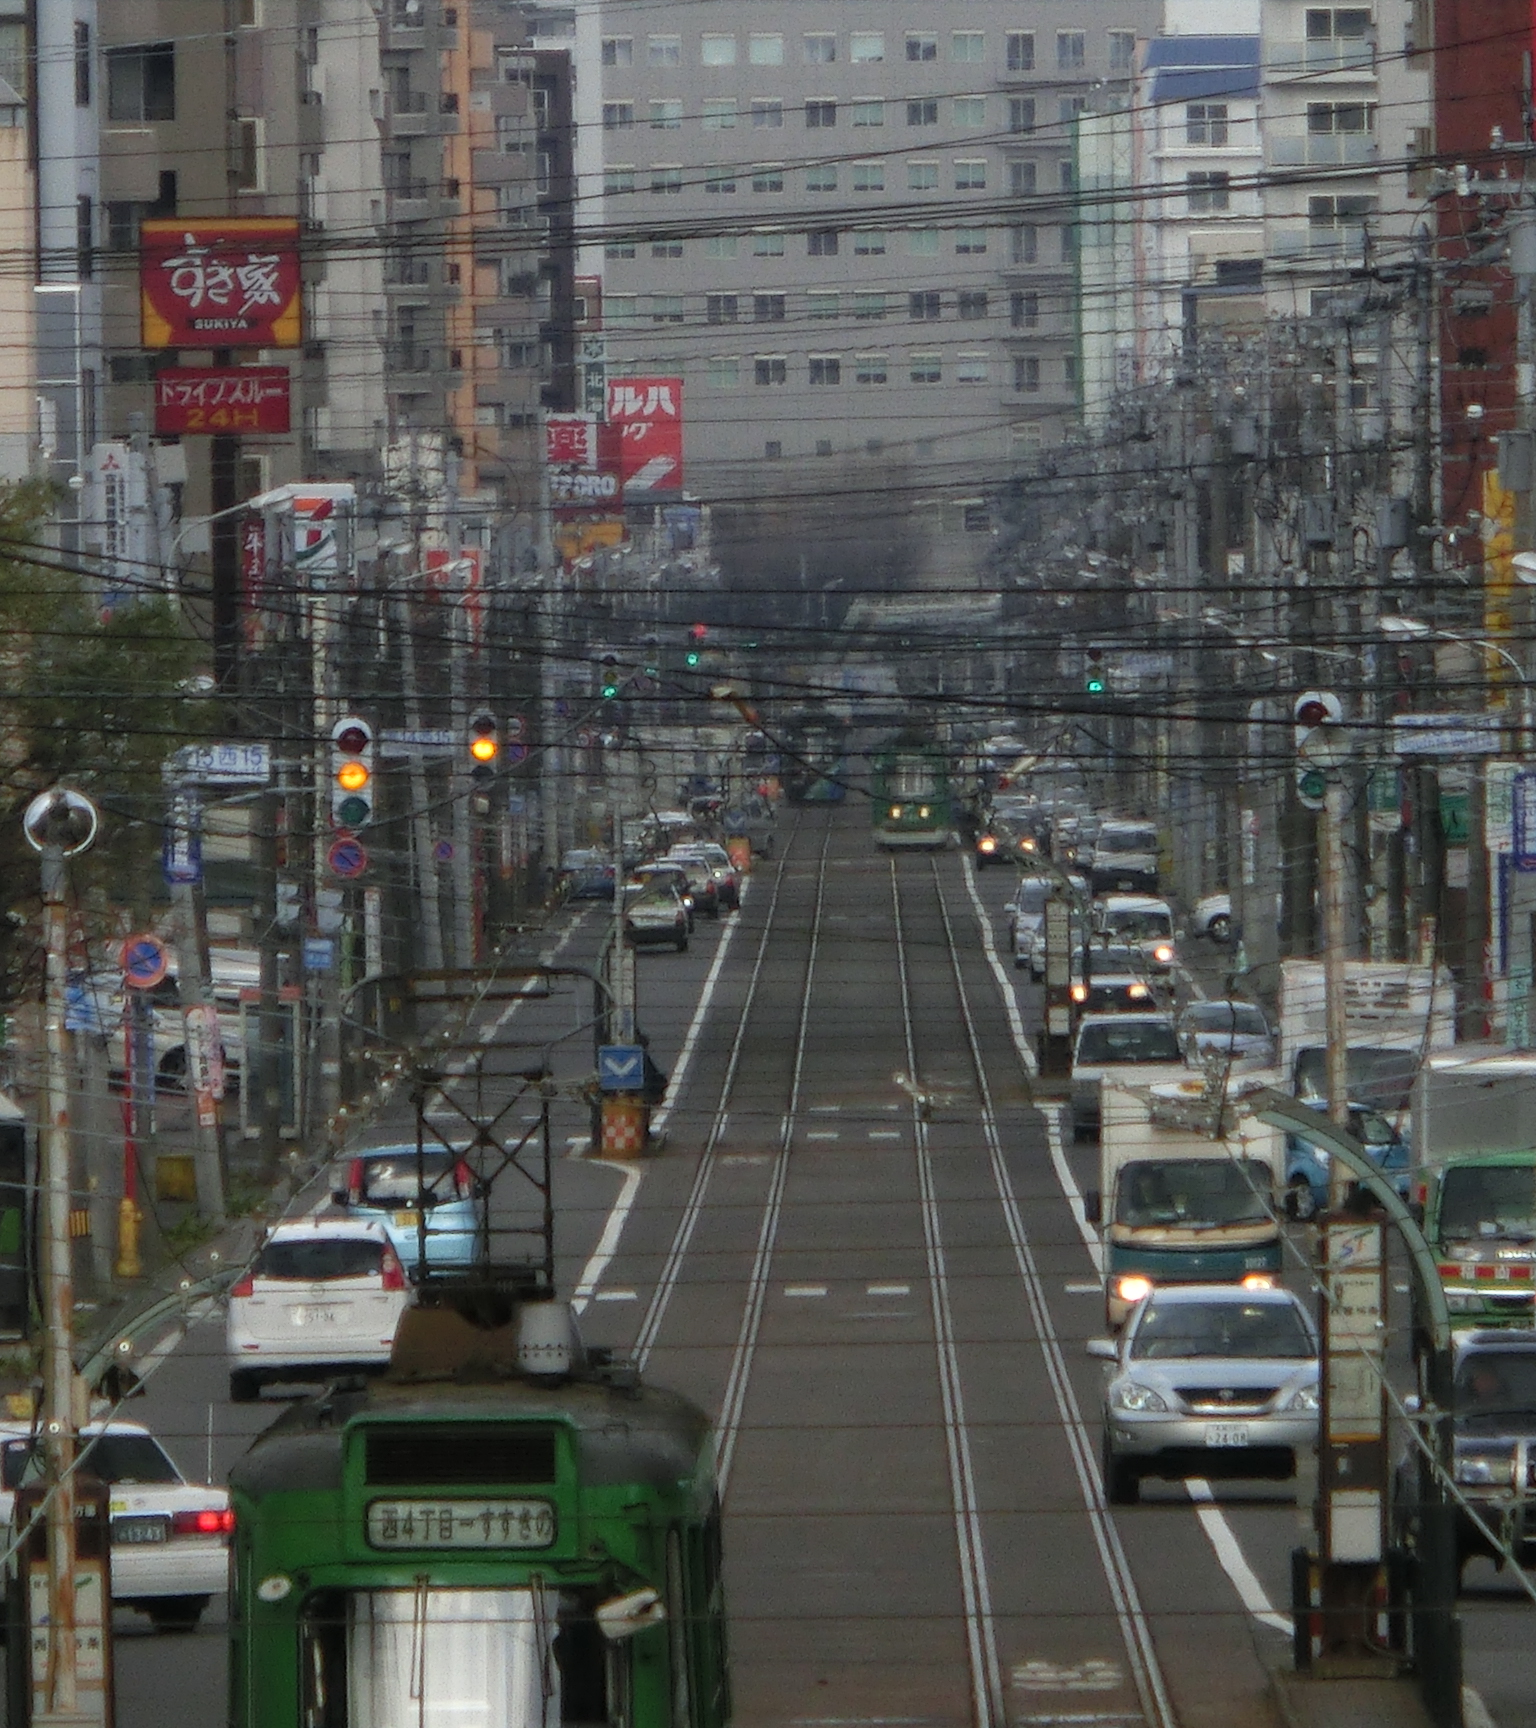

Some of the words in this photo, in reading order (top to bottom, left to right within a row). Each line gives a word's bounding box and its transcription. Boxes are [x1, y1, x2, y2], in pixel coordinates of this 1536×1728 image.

[161, 232, 282, 316] すき家
[194, 318, 248, 330] SUKIYA
[611, 385, 677, 417] ルハ
[185, 408, 260, 426] 24H
